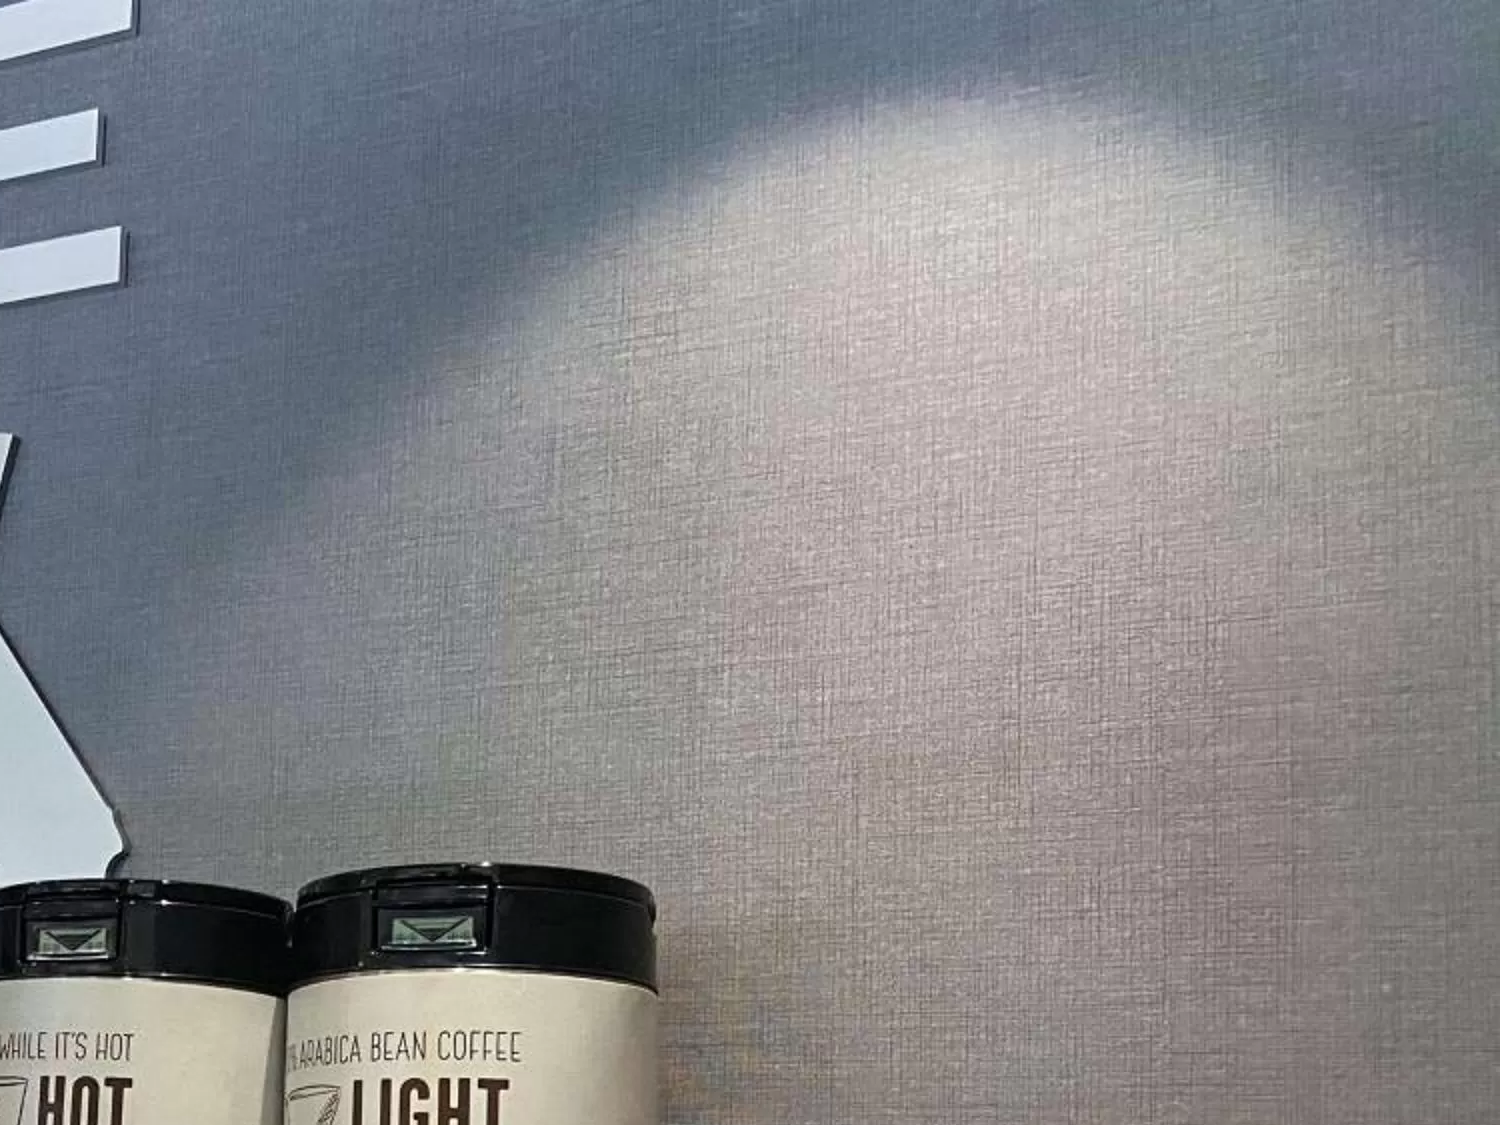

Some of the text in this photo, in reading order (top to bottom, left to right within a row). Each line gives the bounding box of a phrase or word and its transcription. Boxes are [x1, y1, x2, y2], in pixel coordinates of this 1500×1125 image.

[55, 1031, 88, 1061] IT'S
[96, 1032, 135, 1062] HOT
[299, 1034, 362, 1067] ARABICA
[371, 1031, 427, 1062] BEAN
[437, 1030, 522, 1063] COFFEE
